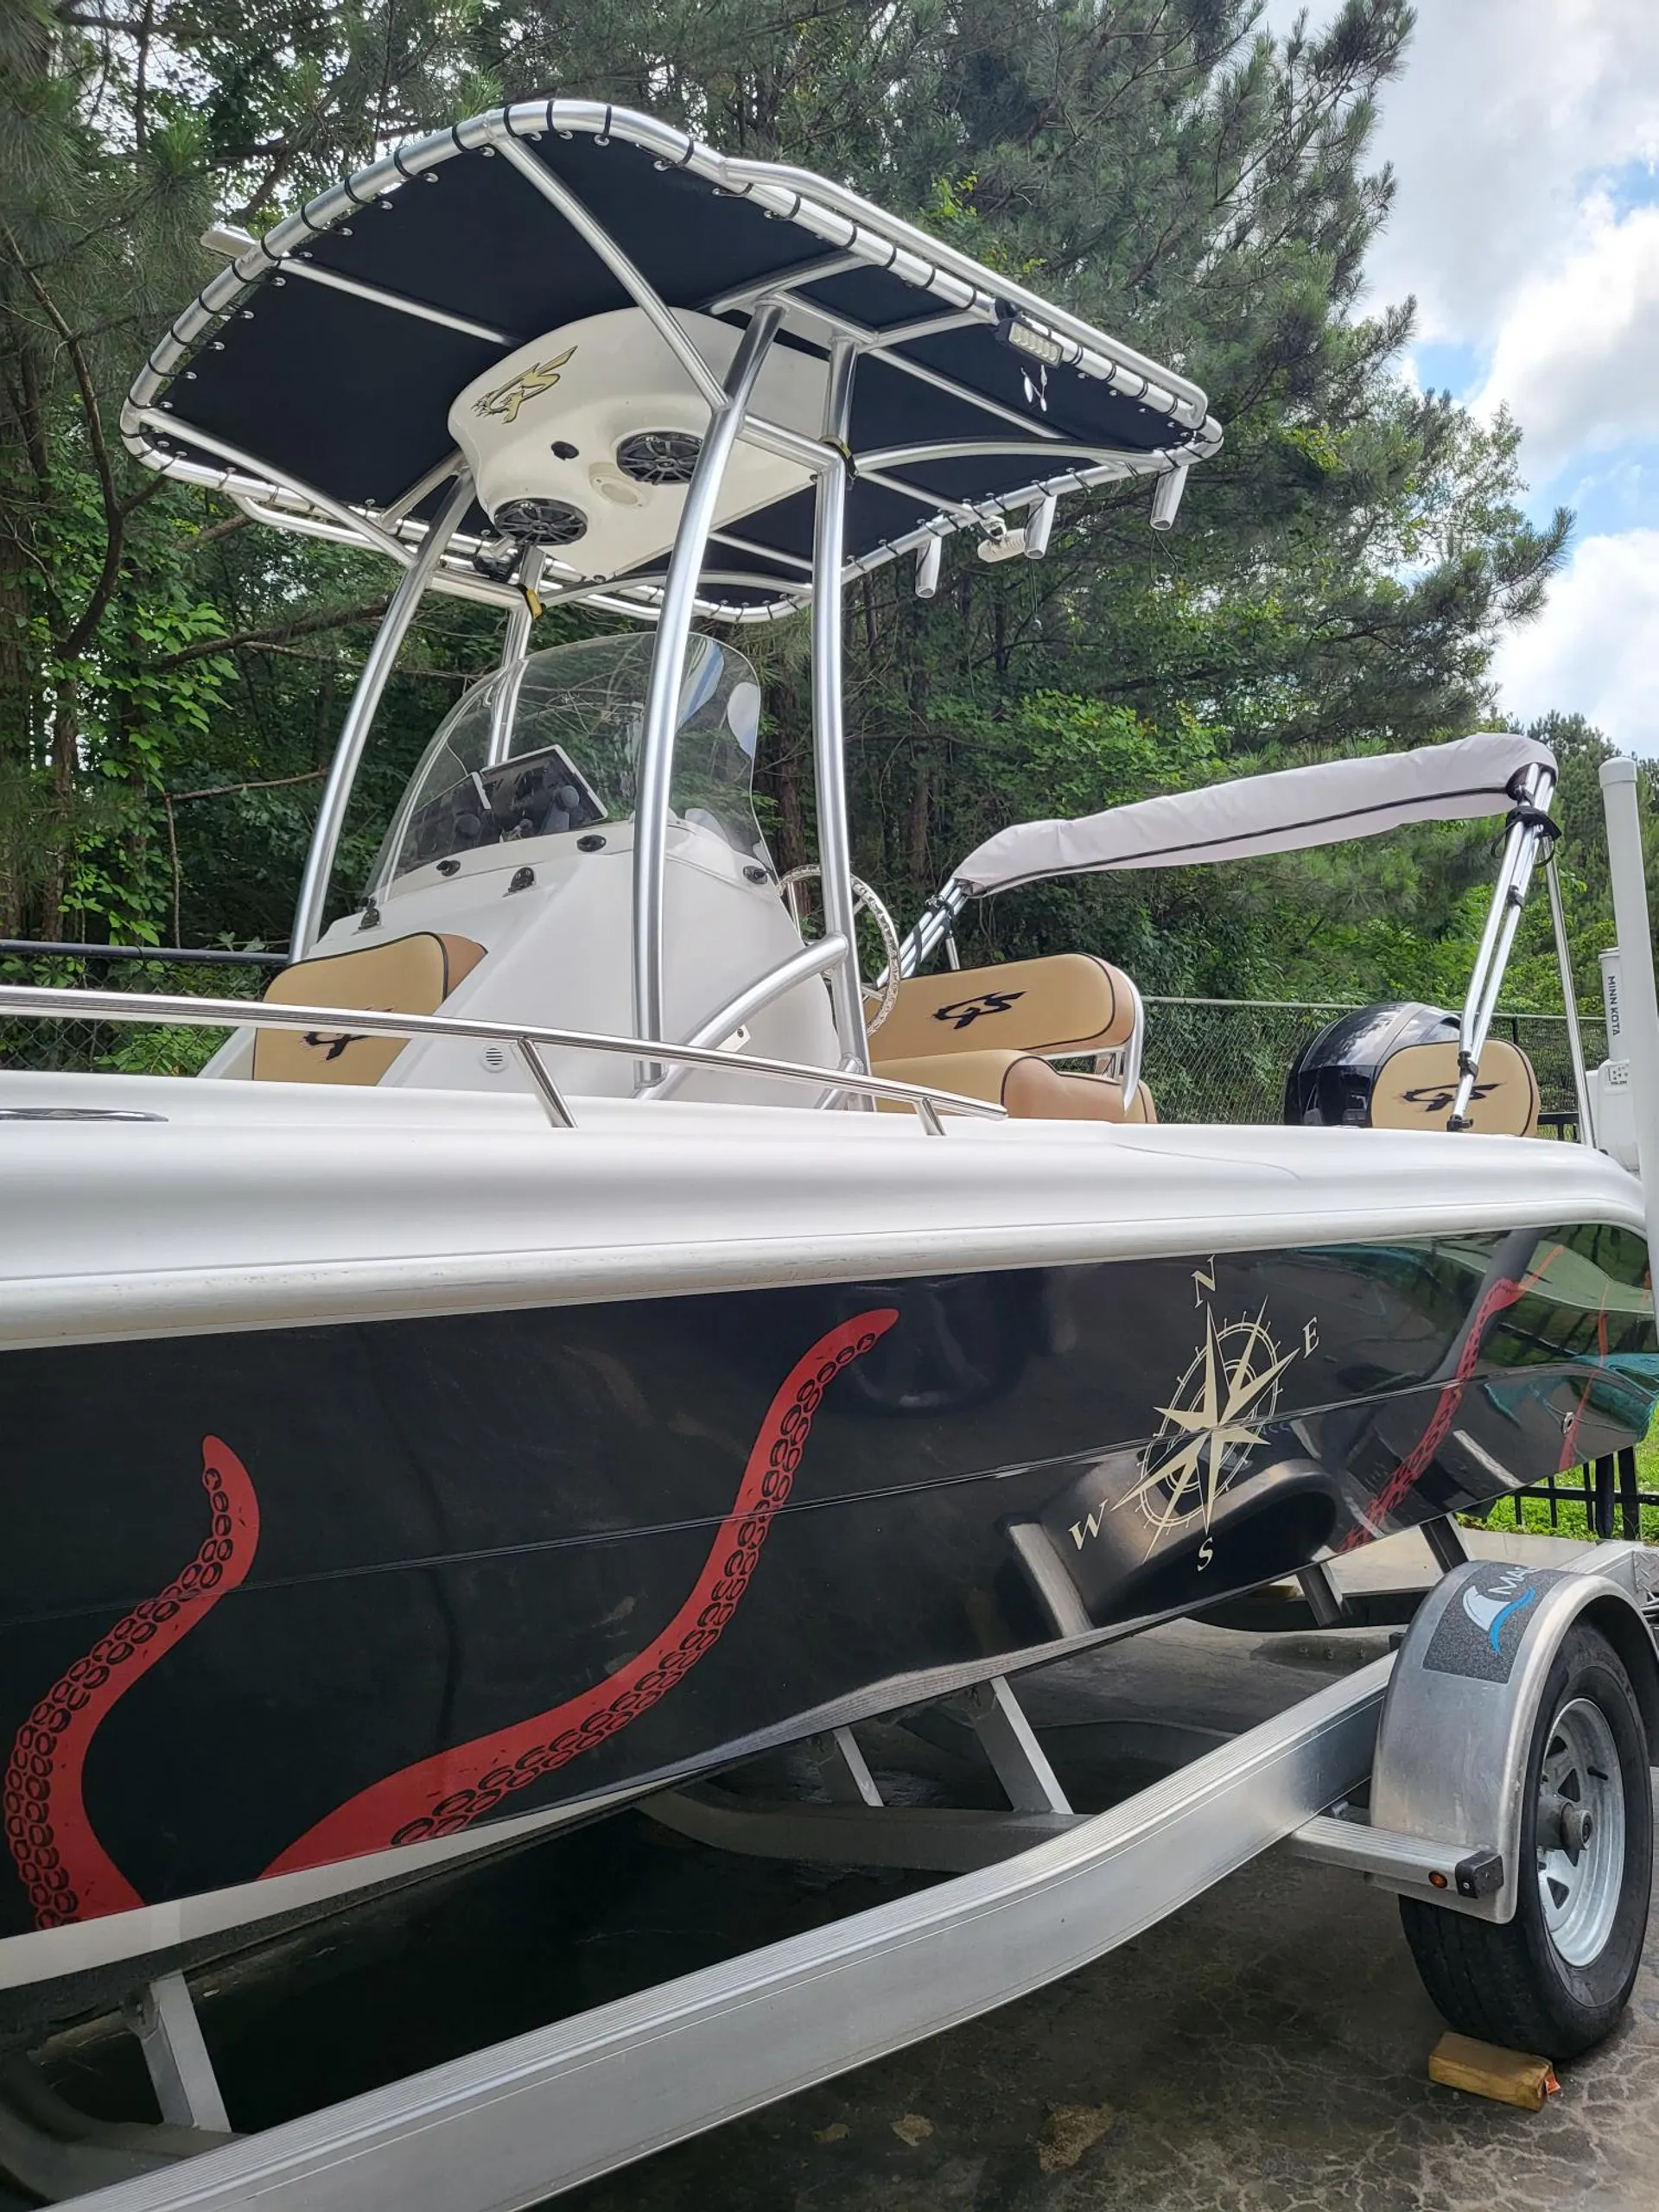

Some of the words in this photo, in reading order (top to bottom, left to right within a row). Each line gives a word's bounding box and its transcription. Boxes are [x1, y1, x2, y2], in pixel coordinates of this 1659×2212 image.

[1608, 976, 1618, 1004] MINN
[1610, 1007, 1620, 1036] KOTA
[1191, 1254, 1216, 1308] N
[1302, 1316, 1320, 1359] E
[1068, 1498, 1109, 1551] W
[1197, 1537, 1214, 1572] S
